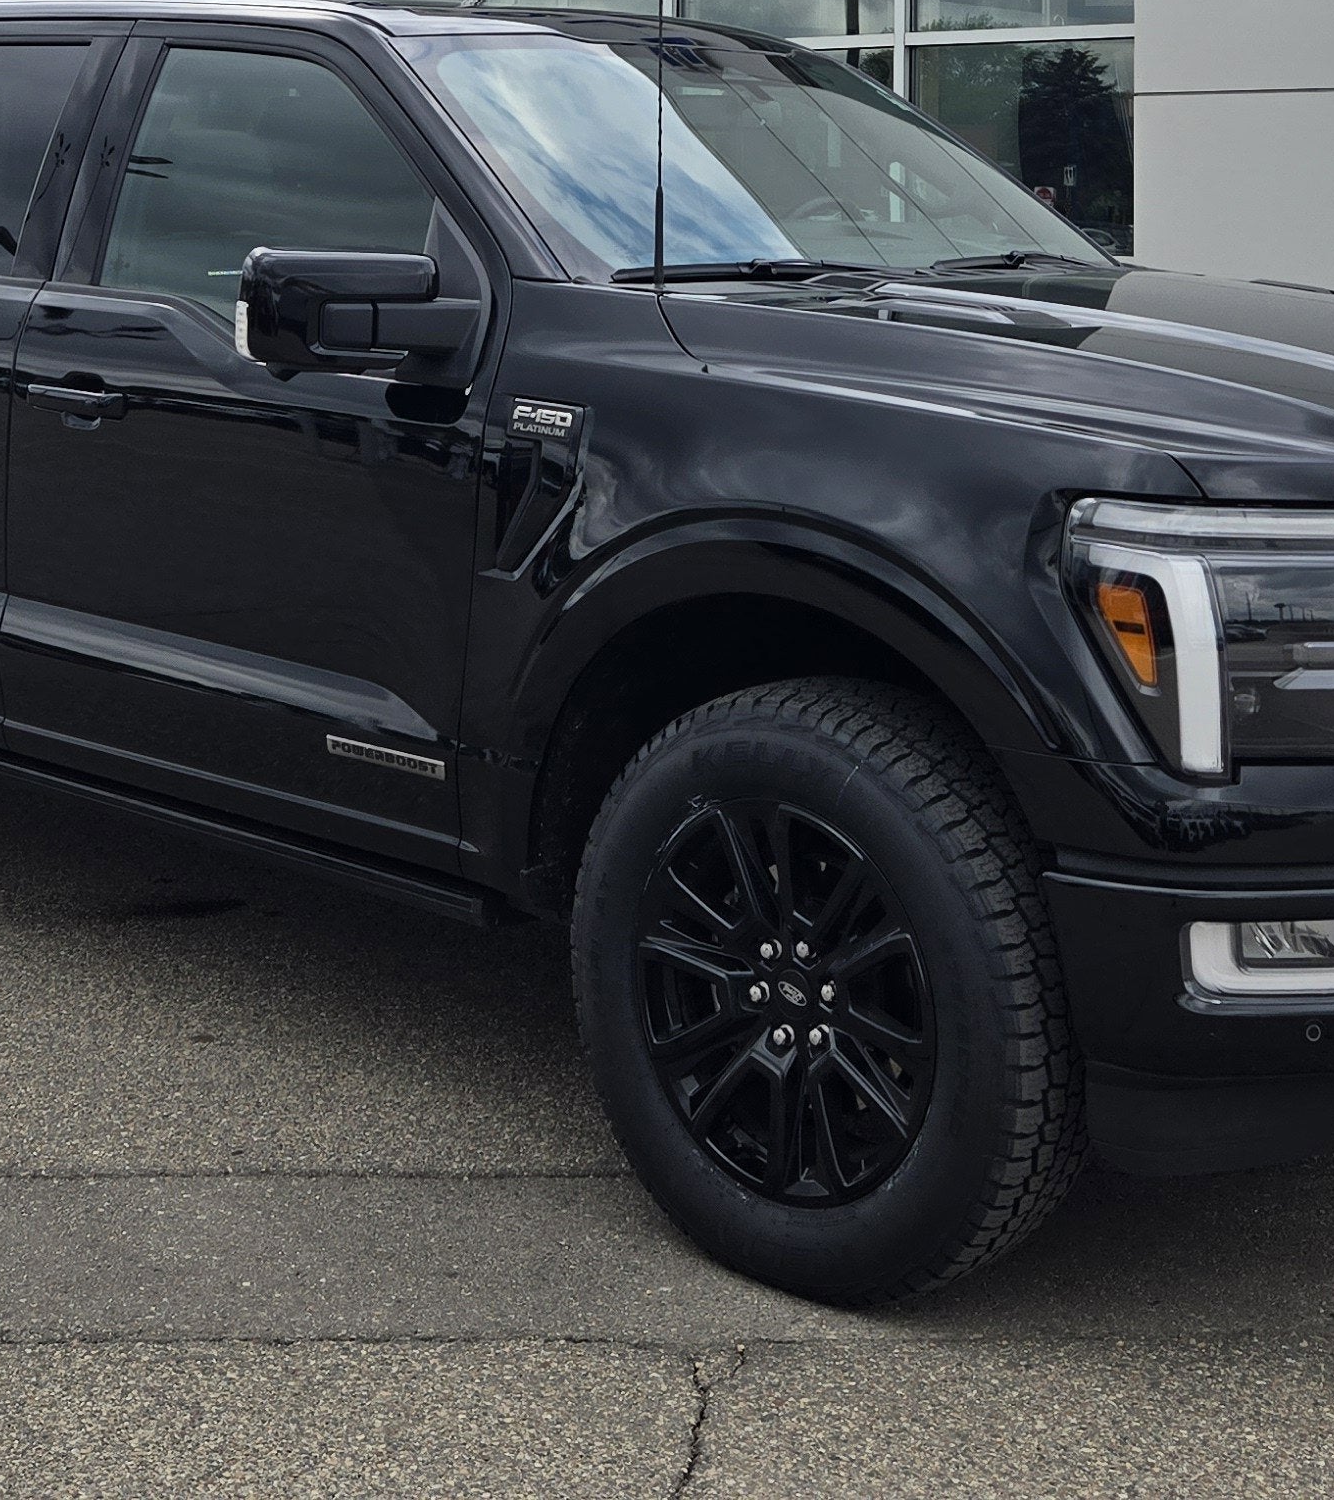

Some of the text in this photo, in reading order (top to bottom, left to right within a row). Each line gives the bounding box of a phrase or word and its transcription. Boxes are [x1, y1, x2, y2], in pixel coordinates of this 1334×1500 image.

[512, 405, 573, 428] F-150
[512, 422, 566, 437] PLATINUM
[331, 739, 438, 775] POWERBOOST
